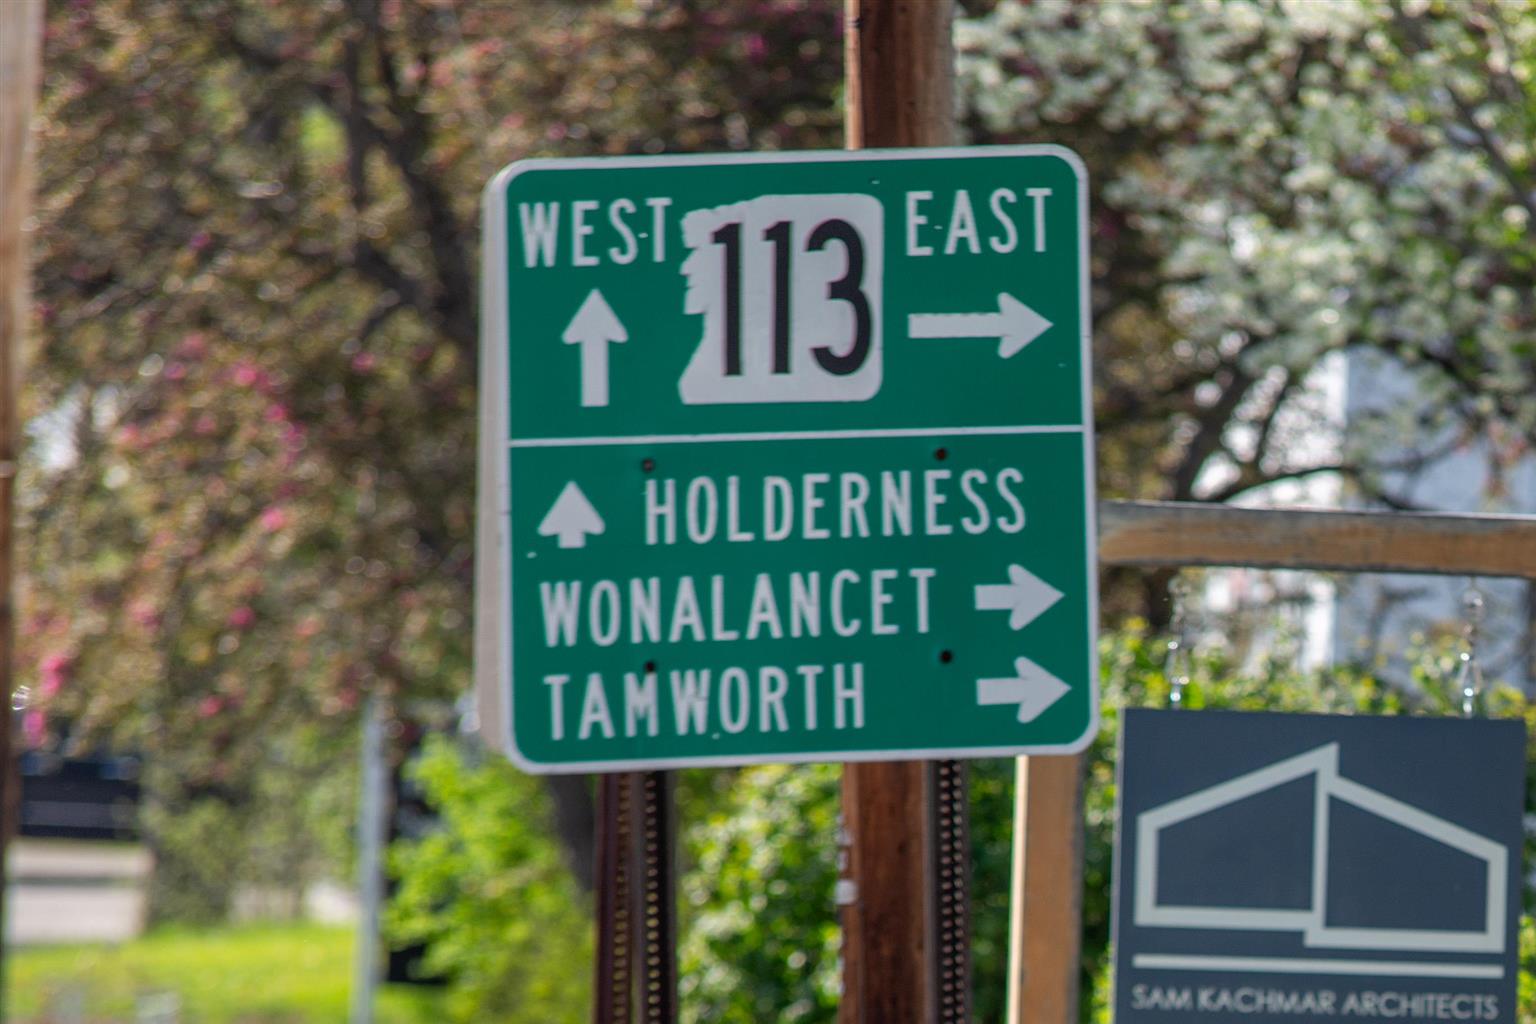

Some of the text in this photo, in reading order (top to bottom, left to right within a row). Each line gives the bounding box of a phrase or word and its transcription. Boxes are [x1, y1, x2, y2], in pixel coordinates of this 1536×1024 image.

[519, 197, 673, 269] WEST
[904, 187, 1053, 258] EAST
[711, 218, 874, 378] 113
[644, 467, 1027, 546] HOLDERNESS
[539, 567, 937, 648] WONALANCET
[543, 662, 866, 741] TAMWORTH
[1130, 984, 1499, 1020] SAM KACHMAR ARCHITECTS
